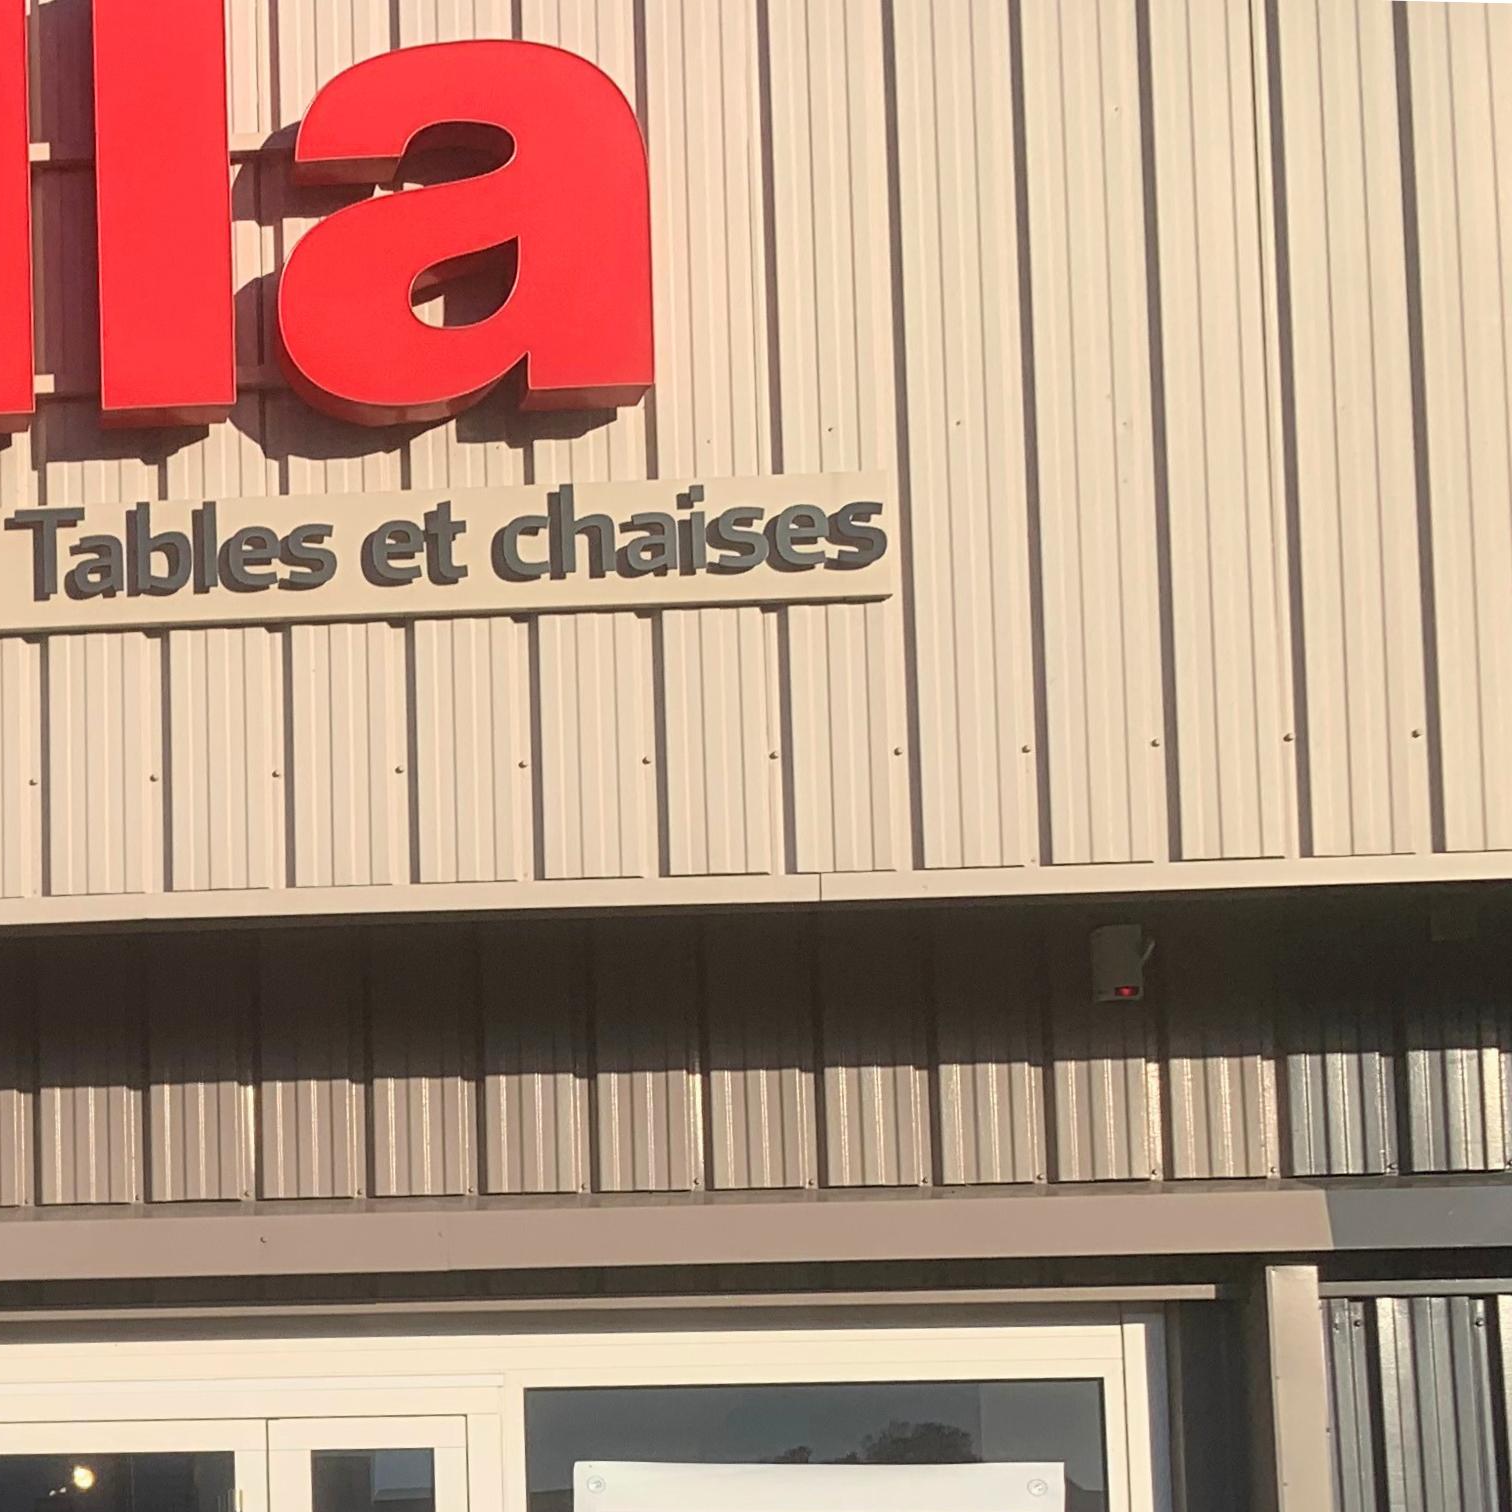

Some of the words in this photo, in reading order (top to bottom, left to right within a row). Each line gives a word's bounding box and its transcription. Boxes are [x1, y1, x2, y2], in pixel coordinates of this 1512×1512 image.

[4, 501, 338, 601] Tables
[360, 500, 468, 587] et
[491, 484, 888, 581] chaises
